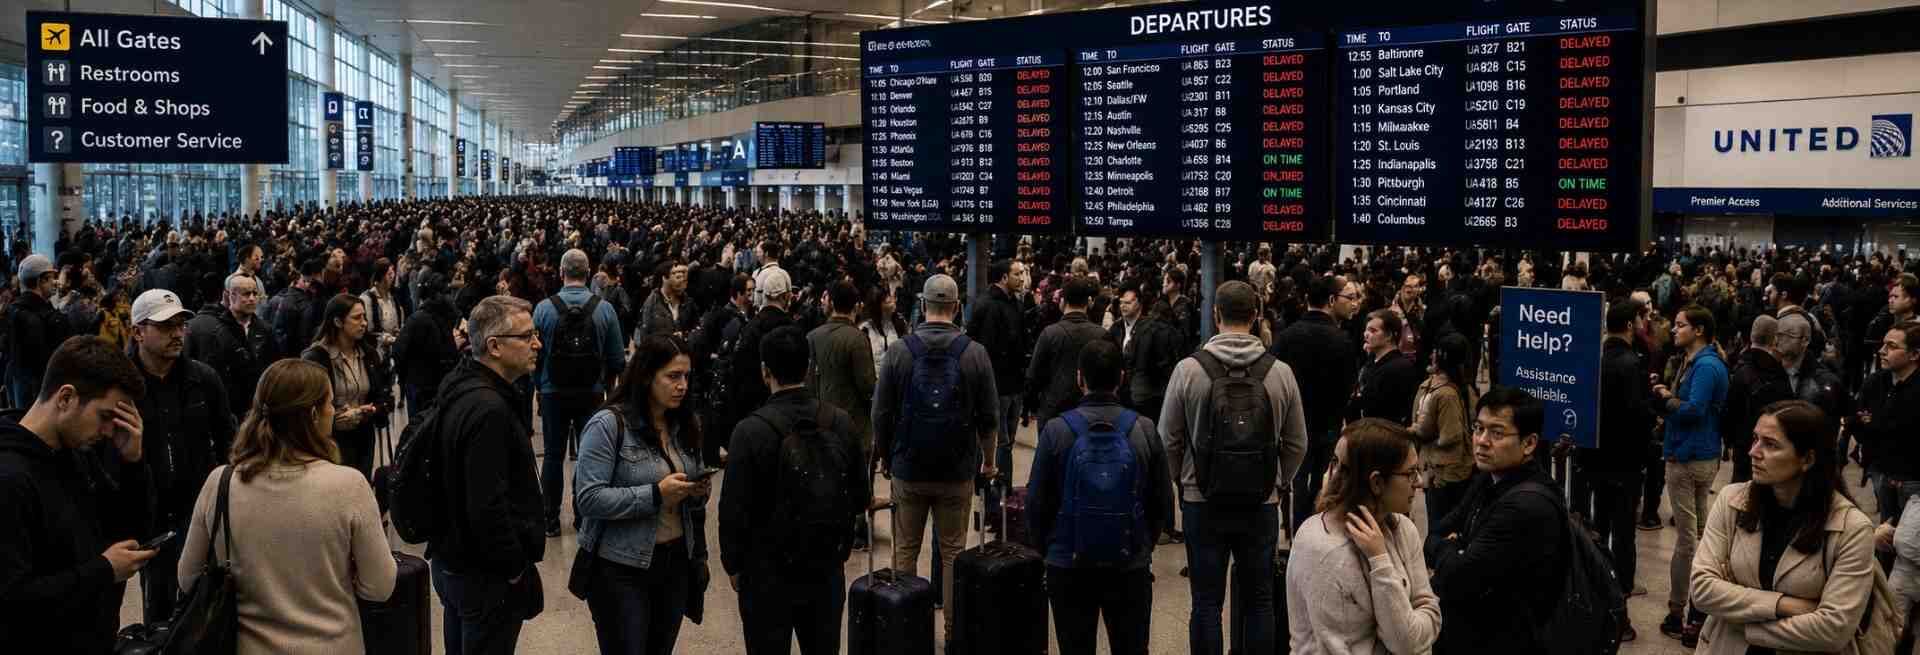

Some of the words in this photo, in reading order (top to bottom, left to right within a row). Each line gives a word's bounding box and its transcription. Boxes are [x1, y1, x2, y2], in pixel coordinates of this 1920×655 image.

[1130, 5, 1271, 35] DEPARTURES
[1346, 33, 1366, 43] TIME
[1378, 32, 1390, 41] TO
[1467, 24, 1499, 36] FLIGHT
[1506, 22, 1530, 33] GATE
[1560, 18, 1596, 29] STATUS
[80, 29, 108, 47] All
[117, 30, 180, 49] Gates
[1507, 42, 1524, 52] B21
[1560, 36, 1610, 48] DELAYED
[1082, 51, 1098, 60] TIME
[1107, 50, 1117, 59] TO
[1181, 44, 1209, 54] FLIGHT
[1215, 42, 1235, 52] GATE
[1263, 38, 1294, 48] STATUS
[950, 60, 973, 69] FLIGHT
[978, 58, 995, 67] GATE
[1017, 56, 1042, 65] STATUS
[1107, 66, 1121, 75] San
[1216, 59, 1231, 68] B23
[1264, 55, 1303, 65] DELAYED
[1379, 67, 1396, 78] Salt
[1400, 66, 1421, 76] Lake
[1425, 65, 1443, 78] City
[1507, 60, 1526, 71] C15
[1560, 56, 1610, 68] DELAYED
[81, 65, 179, 82] Restrooms
[1017, 70, 1049, 80] DELAYED
[1215, 75, 1231, 84] C22
[1264, 71, 1303, 82] DELAYED
[1017, 84, 1050, 94] DELAYED
[1379, 84, 1419, 95] Portland
[1507, 80, 1525, 90] B16
[1560, 76, 1609, 88] DELAYED
[1216, 91, 1231, 100] B11
[1264, 88, 1303, 98] DELAYED
[82, 98, 127, 114] Food
[135, 99, 147, 114] &
[155, 99, 210, 119] Shops
[1017, 99, 1050, 108] DELAYED
[1264, 104, 1303, 115] DELAYED
[1353, 104, 1371, 114] 1:10
[1378, 104, 1413, 113] Kansas
[1416, 102, 1435, 115] City
[1506, 99, 1525, 110] C19
[1560, 96, 1609, 108] DELAYED
[1017, 113, 1049, 123] DELAYED
[1353, 122, 1371, 132] 1:15
[1506, 119, 1519, 129] B4
[1560, 117, 1609, 128] DELAYED
[1018, 128, 1050, 137] DELAYED
[1264, 121, 1303, 131] DELAYED
[82, 131, 171, 147] Customer
[178, 133, 242, 148] Service
[1107, 142, 1125, 150] New
[1126, 140, 1156, 149] Orleans
[1264, 138, 1303, 148] DELAYED
[1353, 140, 1371, 151] 1:20
[1378, 140, 1391, 151] St.
[1394, 140, 1420, 150] Louis
[1506, 139, 1525, 149] B13
[1560, 138, 1608, 148] DELAYED
[1715, 127, 1859, 153] UNITED
[733, 140, 745, 159] A
[1018, 143, 1049, 152] DELAYED
[1018, 157, 1050, 166] DELAYED
[1216, 155, 1230, 164] B14
[1264, 155, 1277, 164] ON
[1280, 154, 1302, 164] TIME
[1505, 159, 1524, 169] C21
[1559, 158, 1608, 169] DELAYED
[1018, 171, 1050, 181] DELAYED
[1353, 177, 1371, 187] 1:30
[1506, 178, 1518, 188] B5
[1559, 178, 1575, 189] ON
[1579, 178, 1605, 189] TIME
[1018, 186, 1050, 195] DELAYED
[1216, 187, 1230, 196] B17
[1264, 188, 1277, 197] ON
[1280, 188, 1302, 198] TIME
[1018, 201, 1050, 210] DELAYED
[1353, 195, 1371, 205] 1:35
[1377, 195, 1426, 207] Cincinnati
[1505, 197, 1524, 208] C26
[1558, 198, 1607, 209] DELAYED
[1691, 196, 1726, 206] Premier
[1728, 197, 1760, 206] Access
[1822, 198, 1871, 208] Additional
[1875, 199, 1917, 208] Services
[1107, 202, 1154, 213] Philadelphia
[1216, 203, 1231, 212] B19
[1264, 204, 1303, 214] DELAYED
[1018, 216, 1050, 224] DELAYED
[1108, 217, 1133, 227] Tampa
[1264, 221, 1303, 231] DELAYED
[1353, 213, 1371, 223] 1:40
[1378, 213, 1425, 224] Columbus
[1505, 217, 1517, 227] B3
[1558, 218, 1607, 230] DELAYED
[1520, 304, 1570, 325] Need
[1518, 330, 1572, 354] Help?
[1516, 366, 1576, 384] Assistance
[1520, 387, 1570, 403] ailable.
